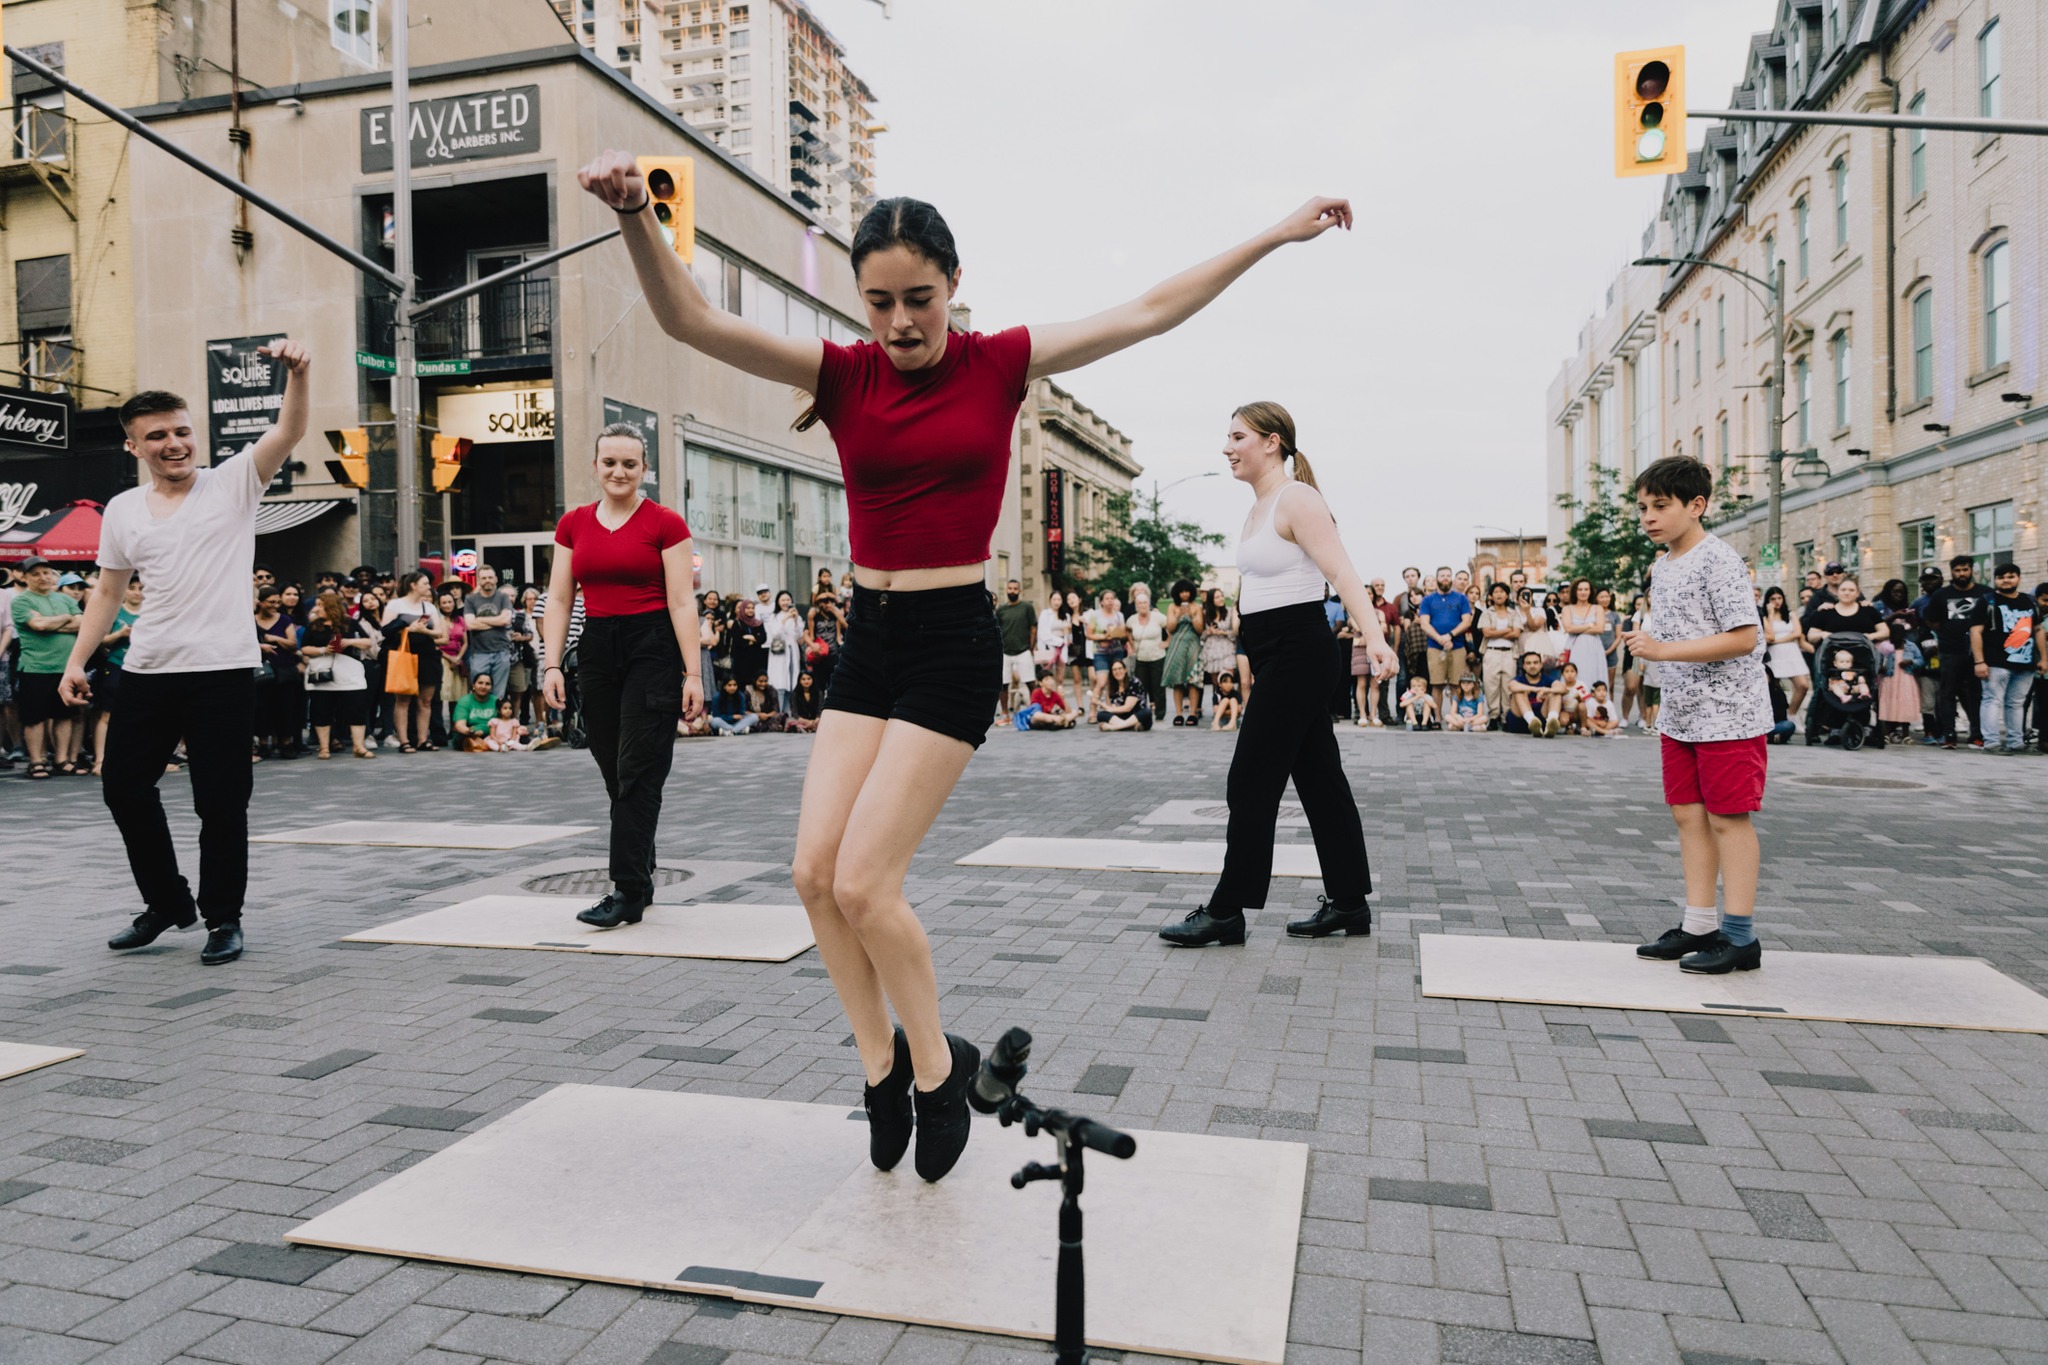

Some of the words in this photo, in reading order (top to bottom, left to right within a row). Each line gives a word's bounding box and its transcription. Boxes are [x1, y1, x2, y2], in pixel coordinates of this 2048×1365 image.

[451, 132, 498, 150] BARBERS
[500, 130, 525, 144] INC.
[240, 352, 262, 367] THE
[357, 353, 386, 369] Talbot
[388, 360, 396, 369] St
[418, 362, 456, 373] Dundas
[459, 362, 469, 371] St
[221, 365, 271, 384] SQUIRE
[214, 398, 240, 414] LOCAL
[240, 396, 263, 412] LIVES
[263, 394, 283, 411] HERE
[513, 392, 544, 411] THE
[488, 410, 555, 433] SQUIRE
[1050, 472, 1059, 527] ROBINSON
[690, 509, 728, 533] SQUIRE
[1051, 543, 1059, 570] HALL
[502, 568, 514, 580] 109
